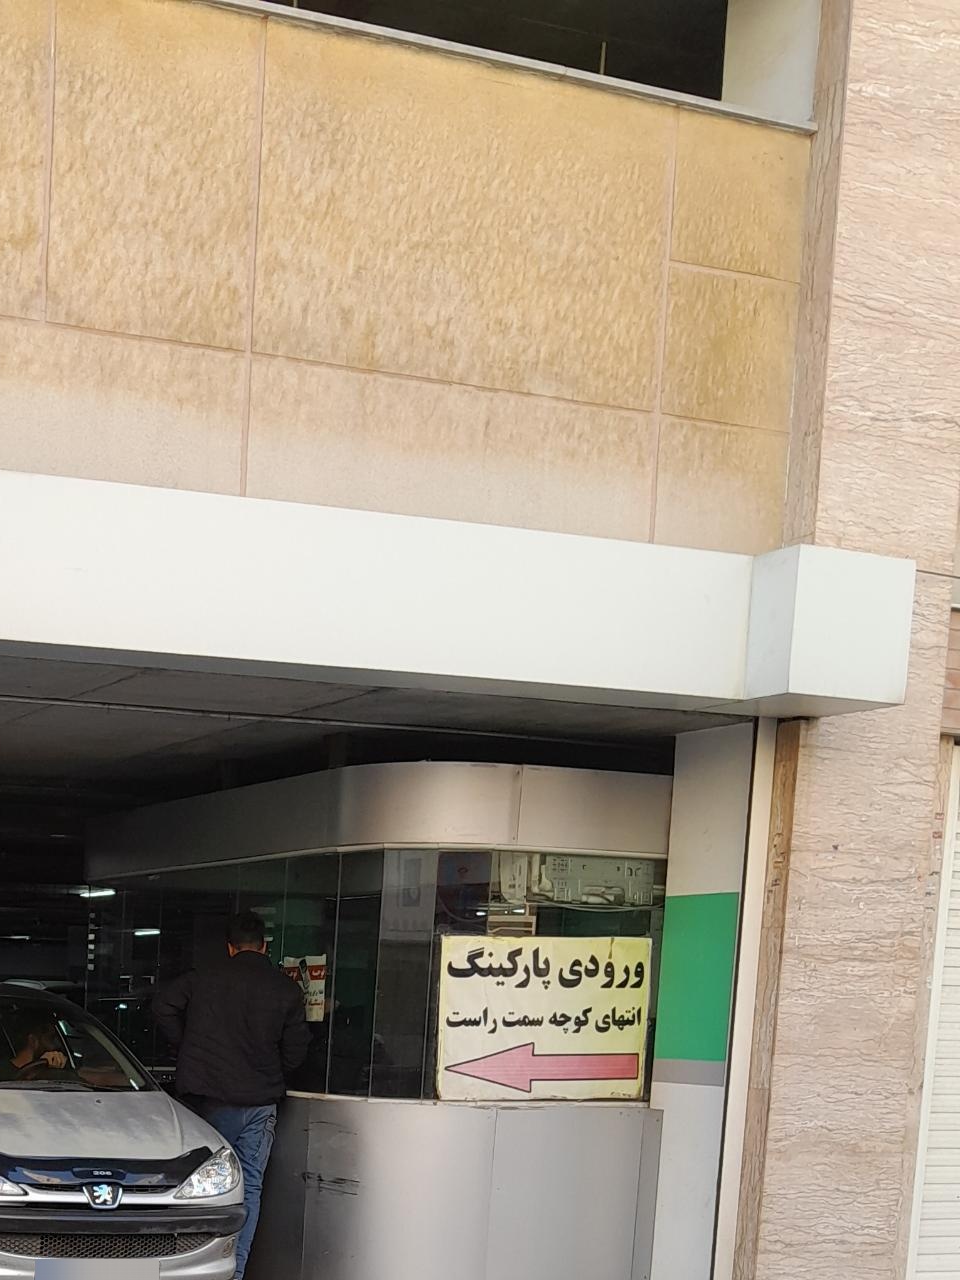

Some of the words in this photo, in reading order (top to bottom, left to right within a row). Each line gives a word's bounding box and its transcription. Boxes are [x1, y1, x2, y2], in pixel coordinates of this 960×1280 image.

[447, 947, 550, 989] پارکینگ
[558, 954, 645, 988] ورودی
[446, 1007, 498, 1034] راست
[502, 1011, 544, 1027] سمت
[549, 1007, 592, 1033] کوچه
[595, 1007, 642, 1033] انتهای
